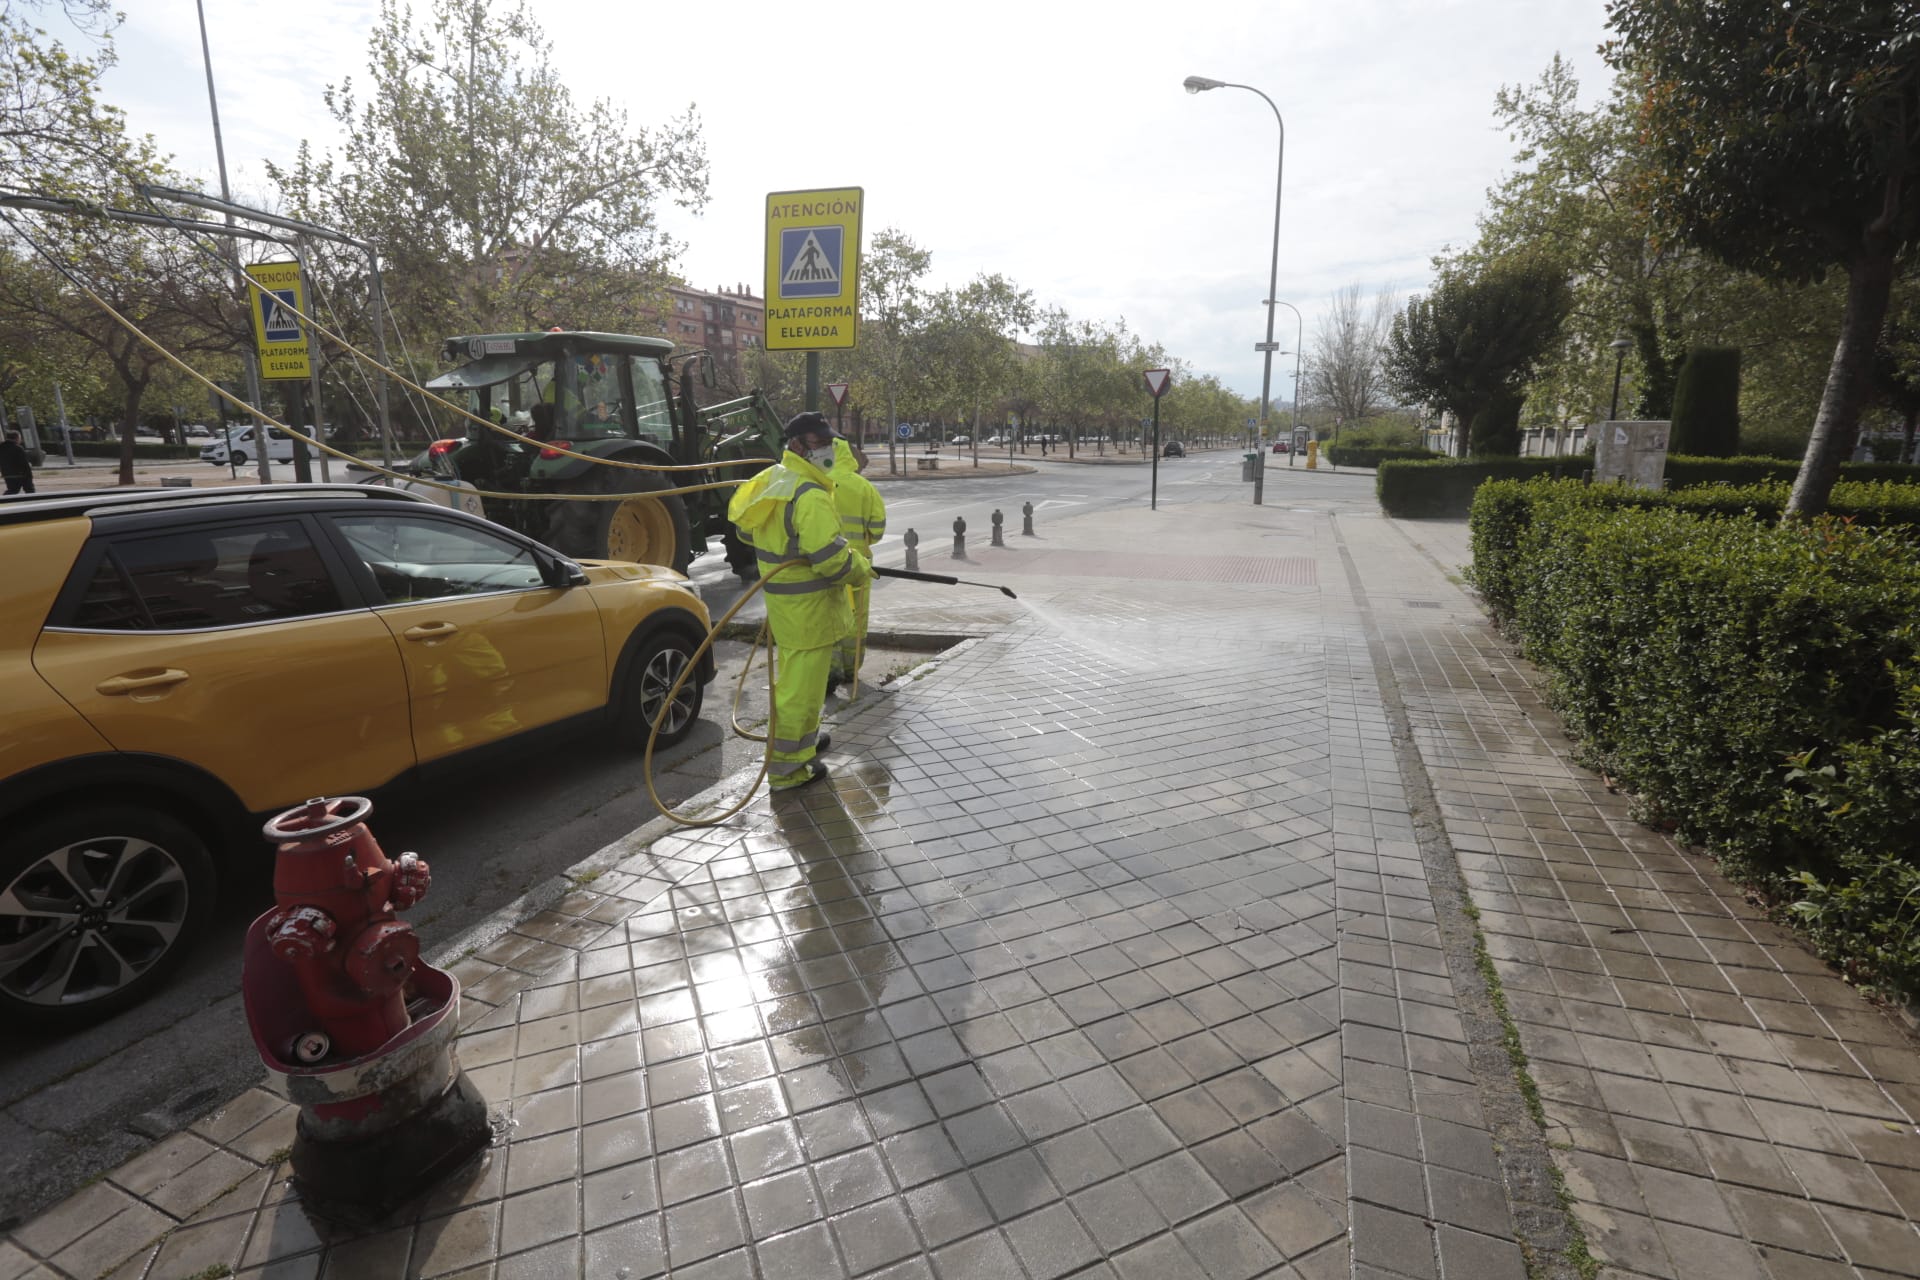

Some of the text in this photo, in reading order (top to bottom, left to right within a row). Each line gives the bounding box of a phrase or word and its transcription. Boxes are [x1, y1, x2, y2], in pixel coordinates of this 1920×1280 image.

[771, 197, 857, 219] ATENCIÓN
[768, 305, 853, 320] PLATAFORMA
[781, 326, 839, 339] ELEVADA
[270, 361, 304, 371] ELEVADA
